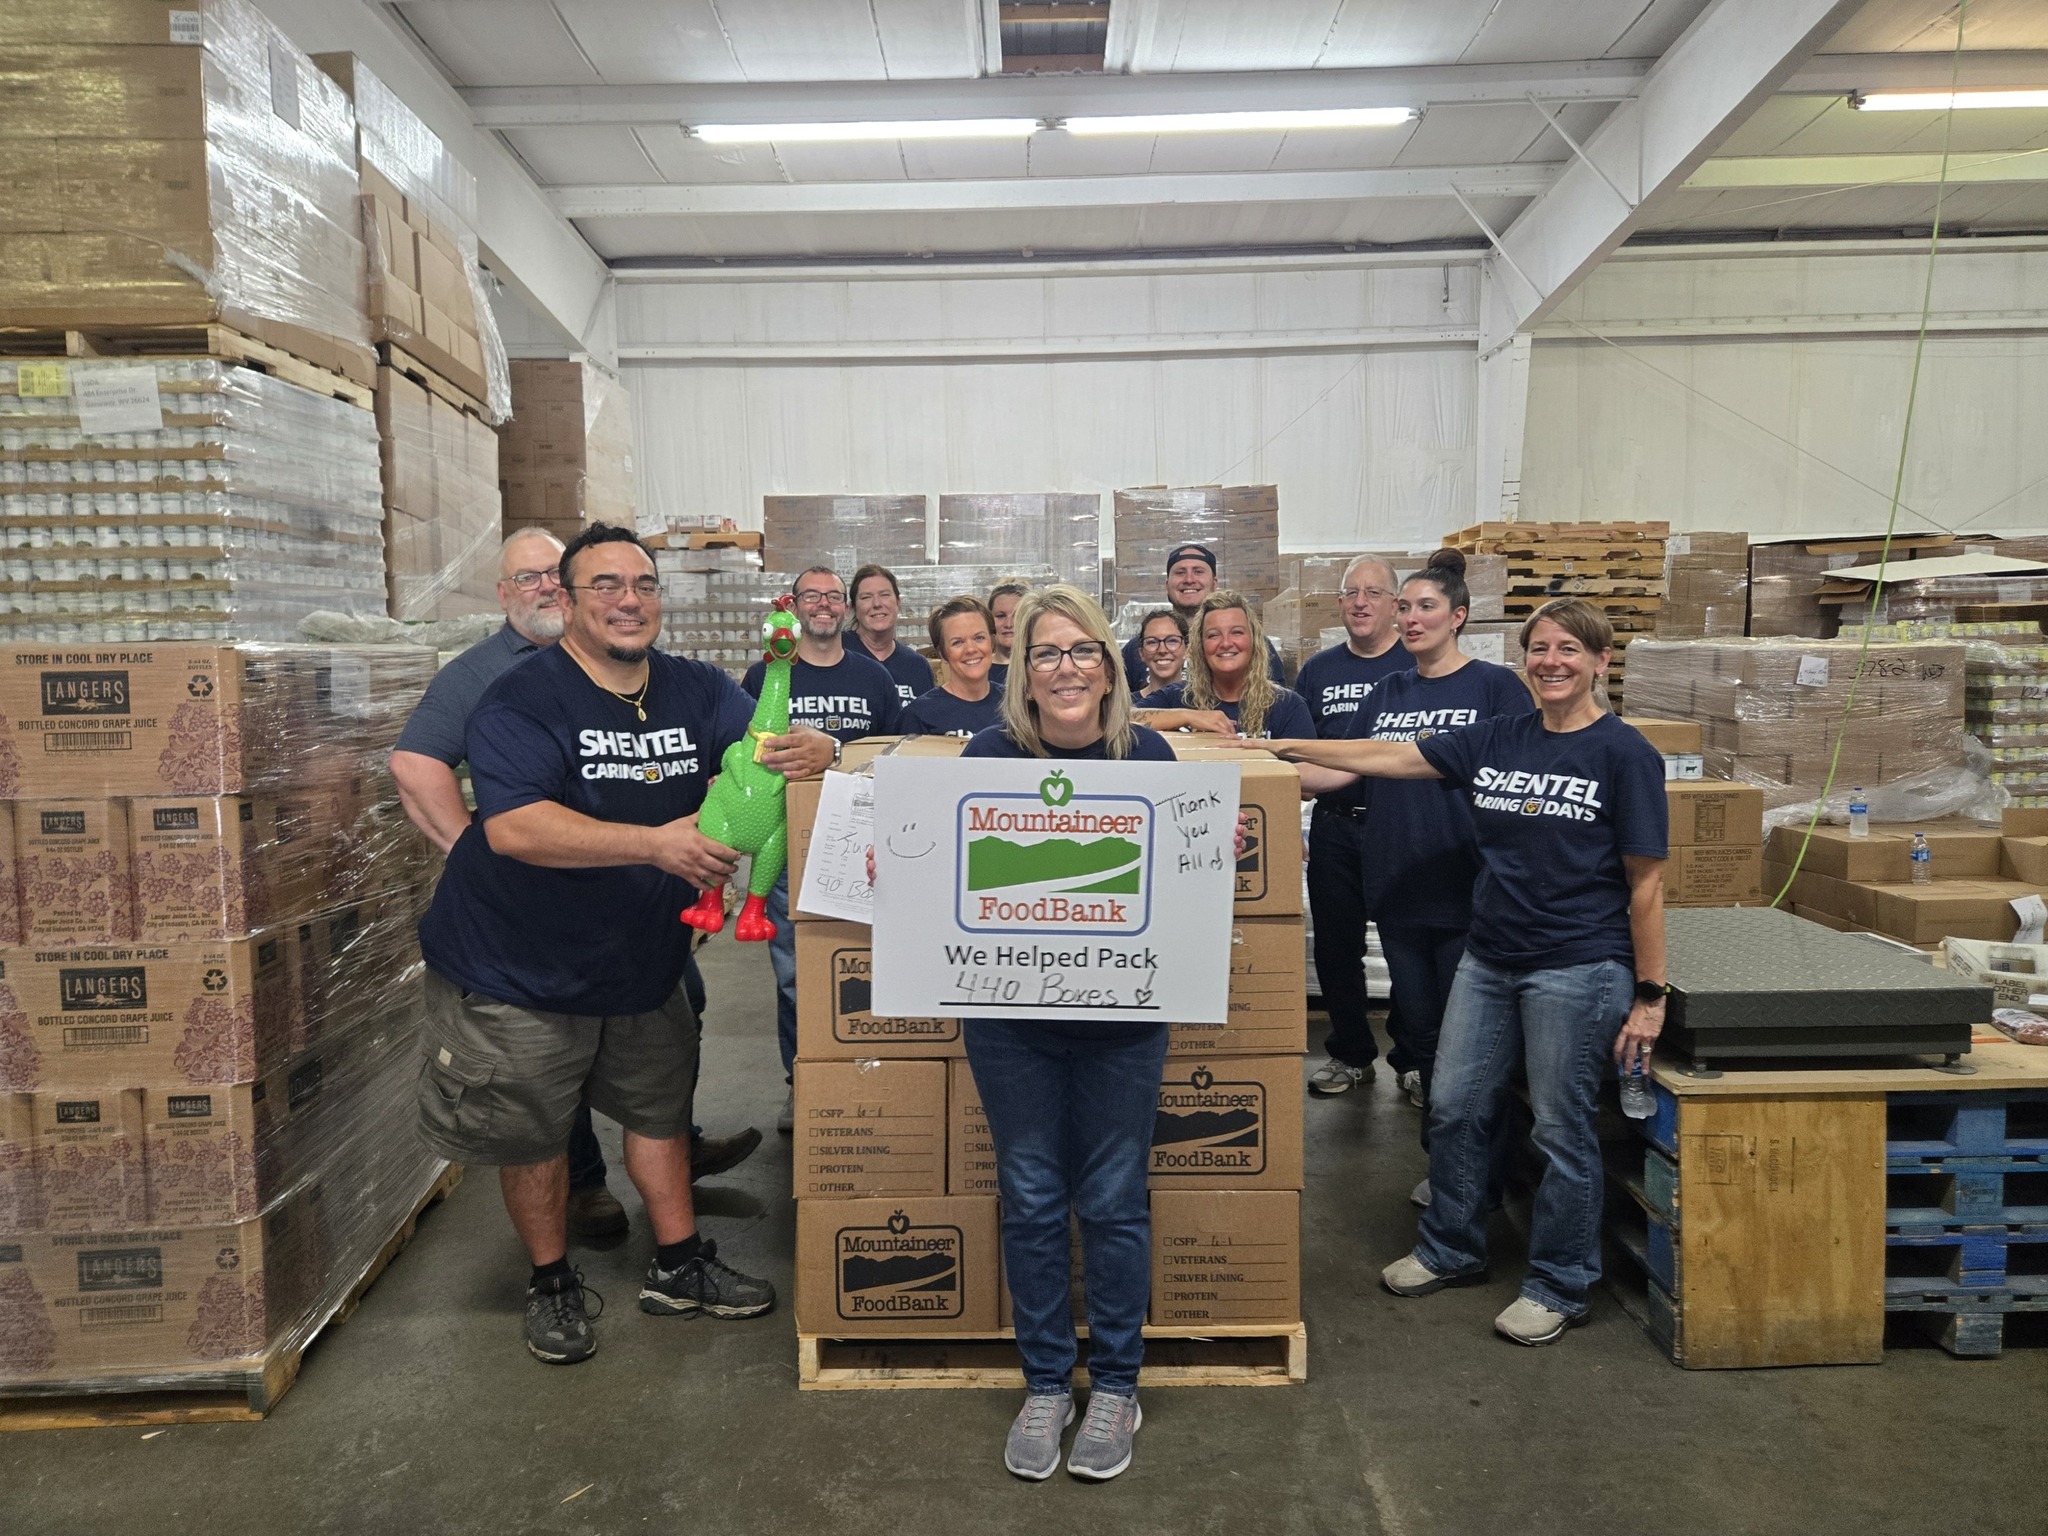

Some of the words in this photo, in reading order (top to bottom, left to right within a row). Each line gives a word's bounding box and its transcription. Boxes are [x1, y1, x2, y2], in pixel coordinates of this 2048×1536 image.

[16, 654, 49, 665] STORE
[52, 654, 62, 664] IN
[66, 654, 93, 664] COOL
[96, 653, 117, 664] DRY
[120, 653, 153, 663] PLACE
[46, 681, 124, 705] LANGERS
[18, 719, 55, 730] BOTTLED
[59, 719, 99, 729] CONCORD
[103, 719, 131, 728] GRAPE
[133, 718, 157, 728] JUICE
[842, 718, 872, 731] DAYS
[579, 728, 697, 760] SHENTEL
[581, 763, 645, 781] CARING
[663, 757, 699, 778] DAYS
[1474, 766, 1602, 808] SHENTEL
[1162, 790, 1221, 822] Thank
[1473, 791, 1521, 812] ARING
[1544, 800, 1596, 822] DAYS
[44, 816, 82, 830] LANGERS
[157, 812, 195, 825] LANGERS
[968, 807, 1143, 835] Mountaineer
[1178, 853, 1203, 874] All
[978, 897, 1127, 923] FoodBank
[35, 952, 67, 962] STORE
[70, 951, 80, 961] IN
[84, 951, 110, 961] COOL
[113, 950, 133, 960] DRY
[136, 950, 169, 960] PLACE
[944, 946, 988, 966] We
[997, 946, 1088, 973] Helped
[1098, 948, 1159, 969] Pack
[65, 976, 142, 1001] LANGERS
[955, 971, 1022, 1003] 440
[1040, 974, 1119, 1007] Boxes
[1994, 978, 2027, 988] LABEL
[1993, 986, 2028, 995] OTHER
[38, 1015, 75, 1026] BOTTLED
[78, 1014, 117, 1025] CONCORD
[120, 1013, 148, 1023] GRAPE
[150, 1012, 173, 1022] JUICE
[847, 1018, 945, 1035] FoodBank
[1180, 1023, 1224, 1031] PROTEIN
[1180, 1041, 1215, 1049] OTHER
[59, 1106, 97, 1119] LANGERS
[170, 1100, 208, 1113] LANGERS
[819, 1109, 845, 1118] CSFP
[819, 1128, 874, 1137] VETERANS
[819, 1146, 854, 1155] SILVER
[856, 1146, 890, 1155] LINING
[1154, 1151, 1251, 1167] FoodBank
[819, 1165, 864, 1174] PROTEIN
[819, 1183, 855, 1191] OTHER
[152, 1231, 183, 1241] PLACE
[1173, 1237, 1197, 1246] CSFP
[843, 1235, 955, 1253] Mountaineer
[1173, 1255, 1227, 1264] VETERANS
[83, 1256, 157, 1282] LANGERS
[1173, 1274, 1208, 1283] SILVER
[1210, 1274, 1244, 1282] LINING
[165, 1291, 188, 1301] JUICE
[1174, 1292, 1218, 1301] PROTEIN
[852, 1295, 949, 1313] FoodBank
[1174, 1310, 1210, 1318] OTHER
